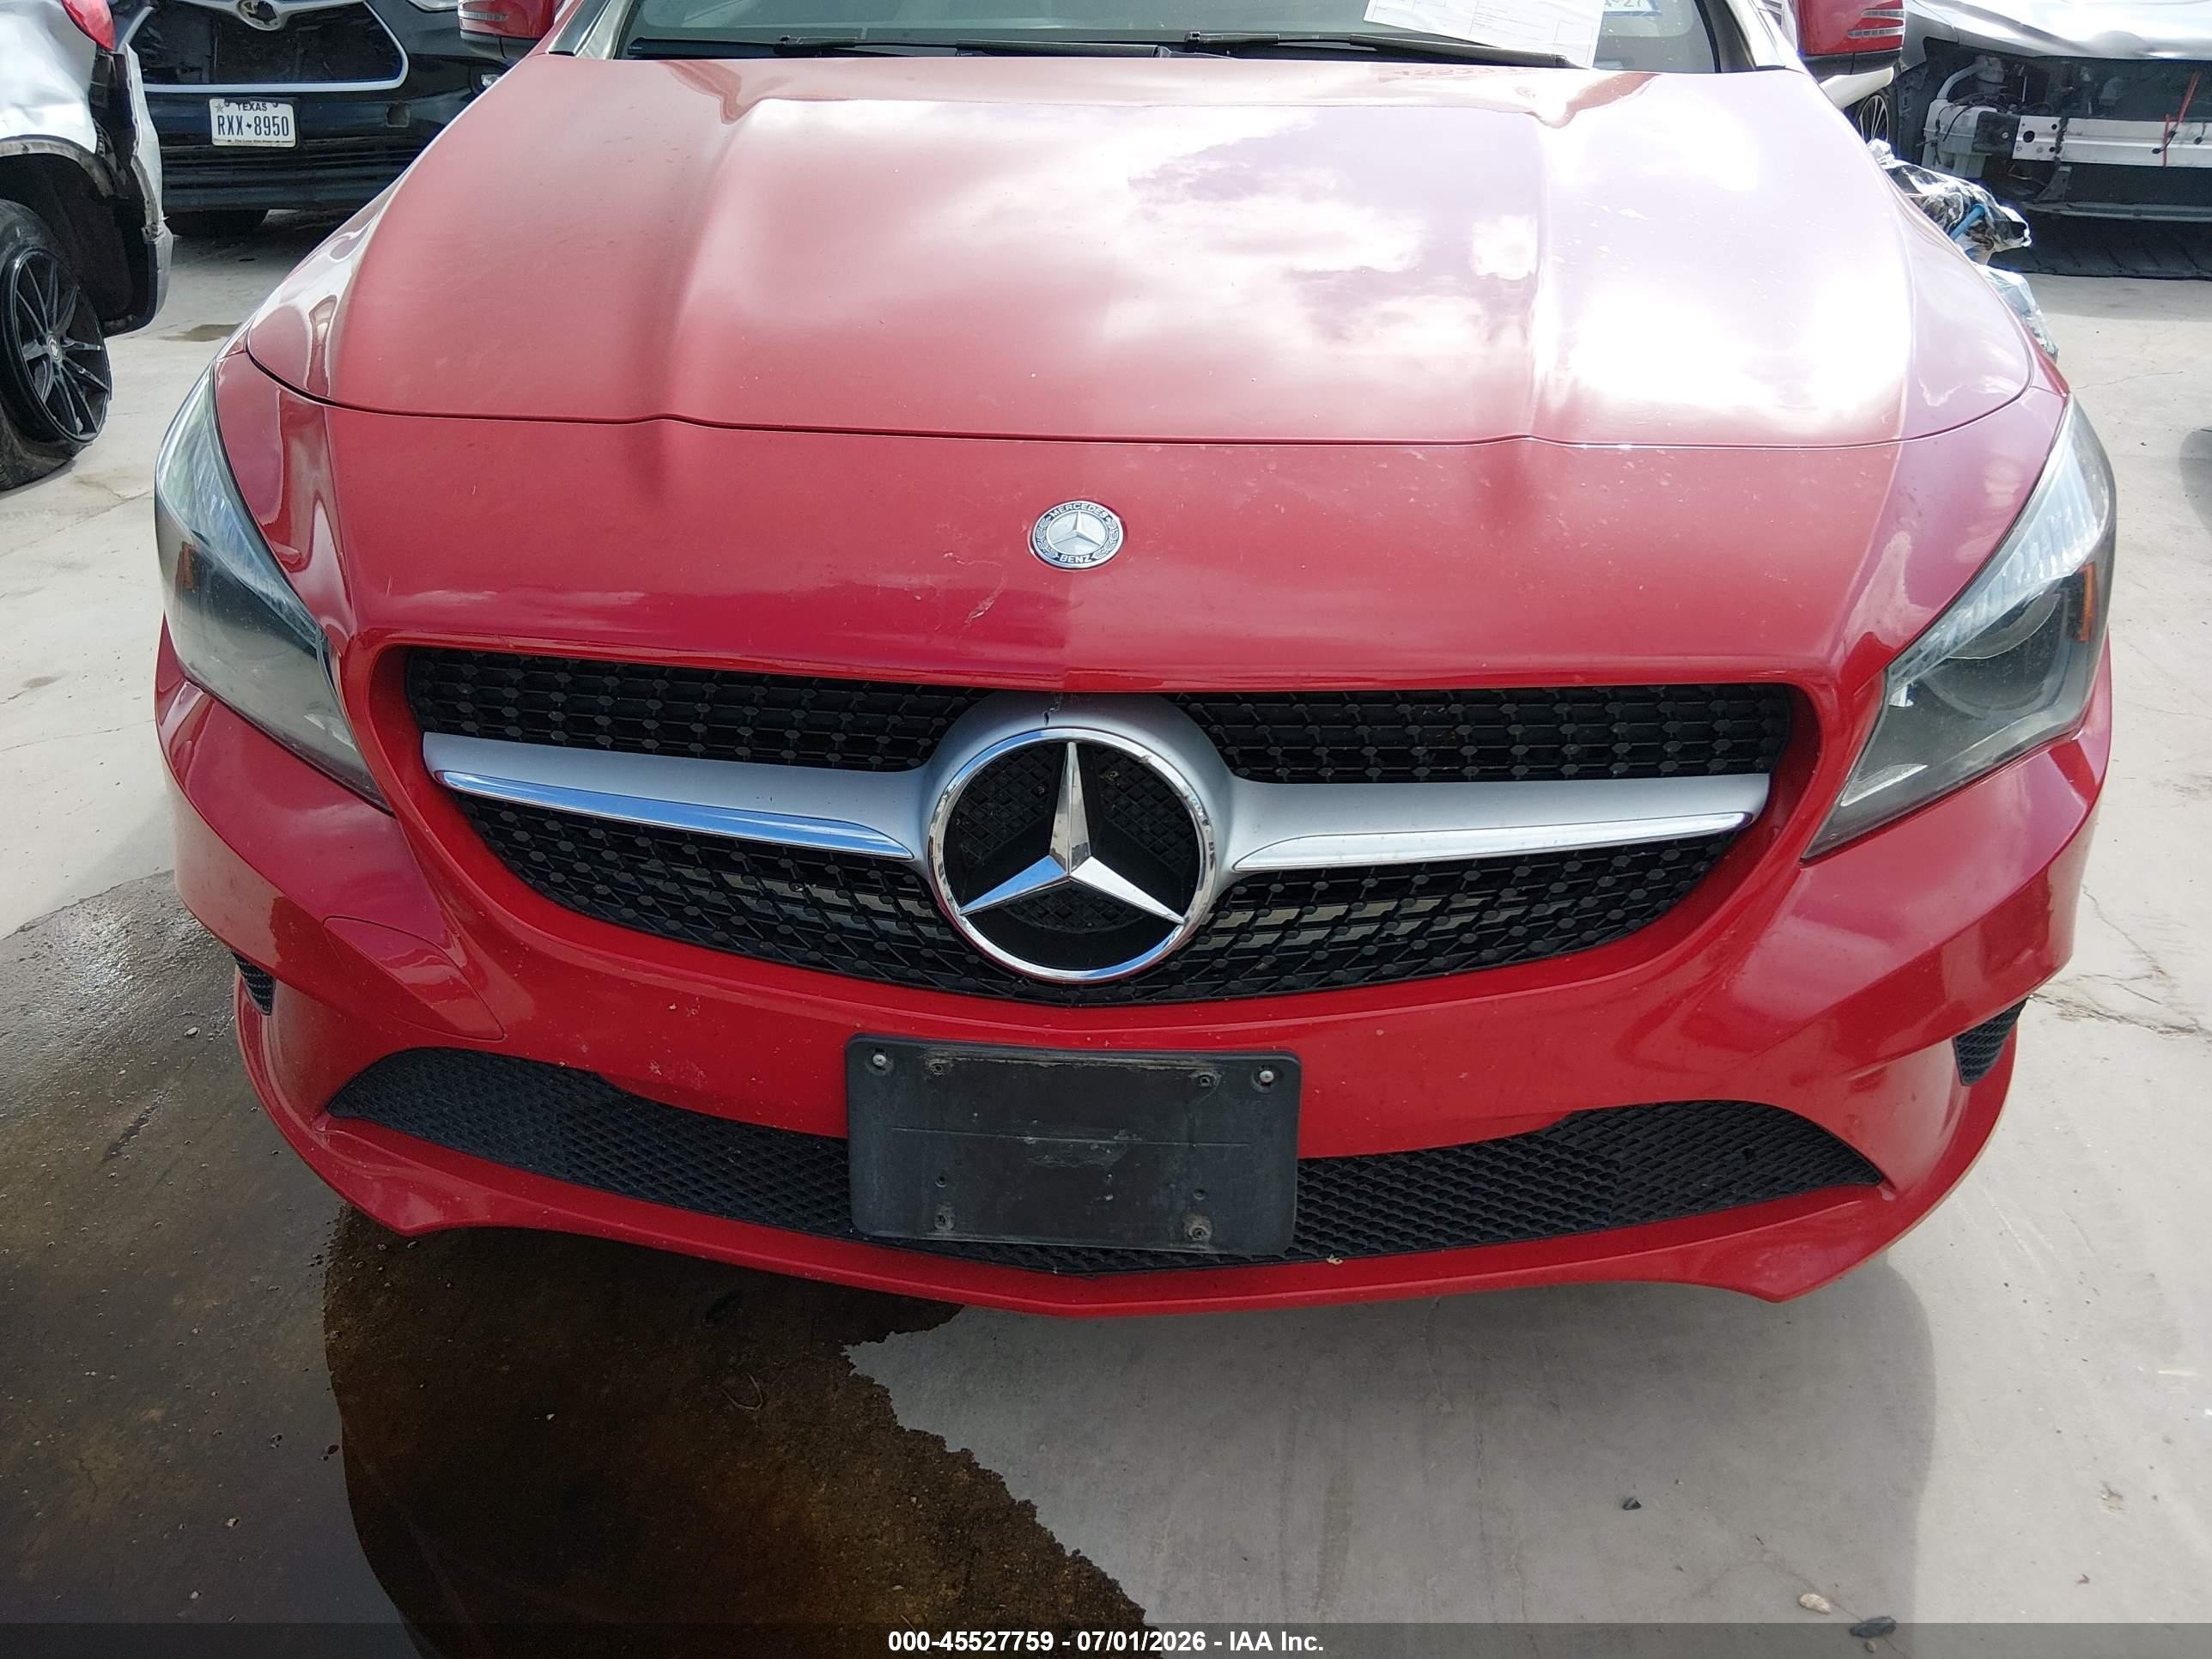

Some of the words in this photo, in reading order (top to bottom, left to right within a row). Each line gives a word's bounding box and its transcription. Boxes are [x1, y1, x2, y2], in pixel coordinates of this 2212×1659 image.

[236, 102, 268, 112] TEXAS
[1048, 502, 1109, 519] MERCEDES
[1059, 555, 1093, 563] BENZ
